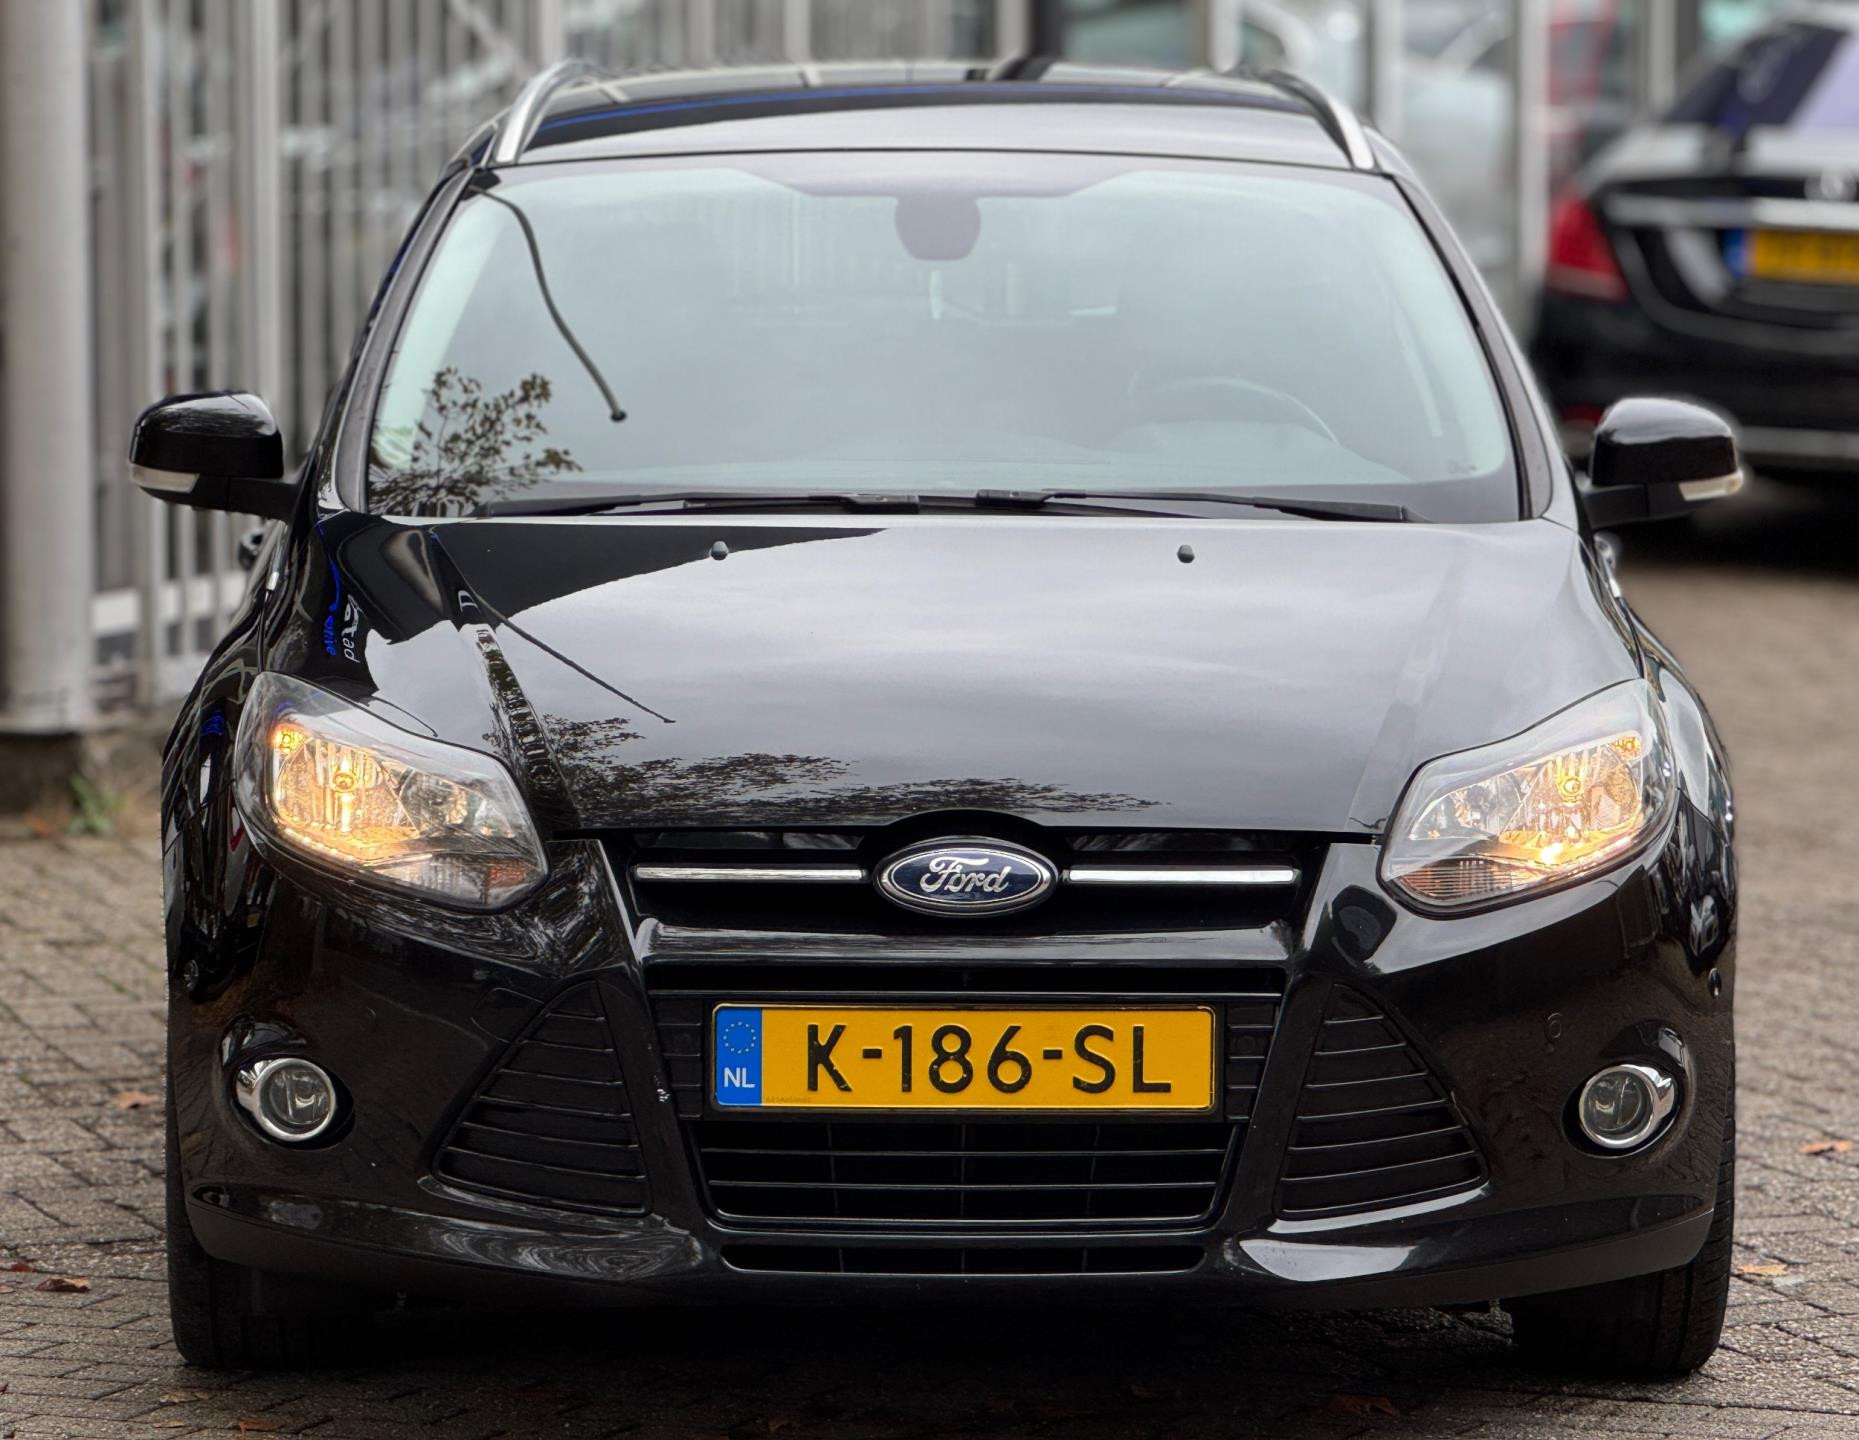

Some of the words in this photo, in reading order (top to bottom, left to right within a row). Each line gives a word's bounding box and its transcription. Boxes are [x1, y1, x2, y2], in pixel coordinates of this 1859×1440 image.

[920, 856, 1012, 892] Ford
[807, 1024, 1171, 1093] K-186-SL
[723, 1067, 755, 1088] NL
